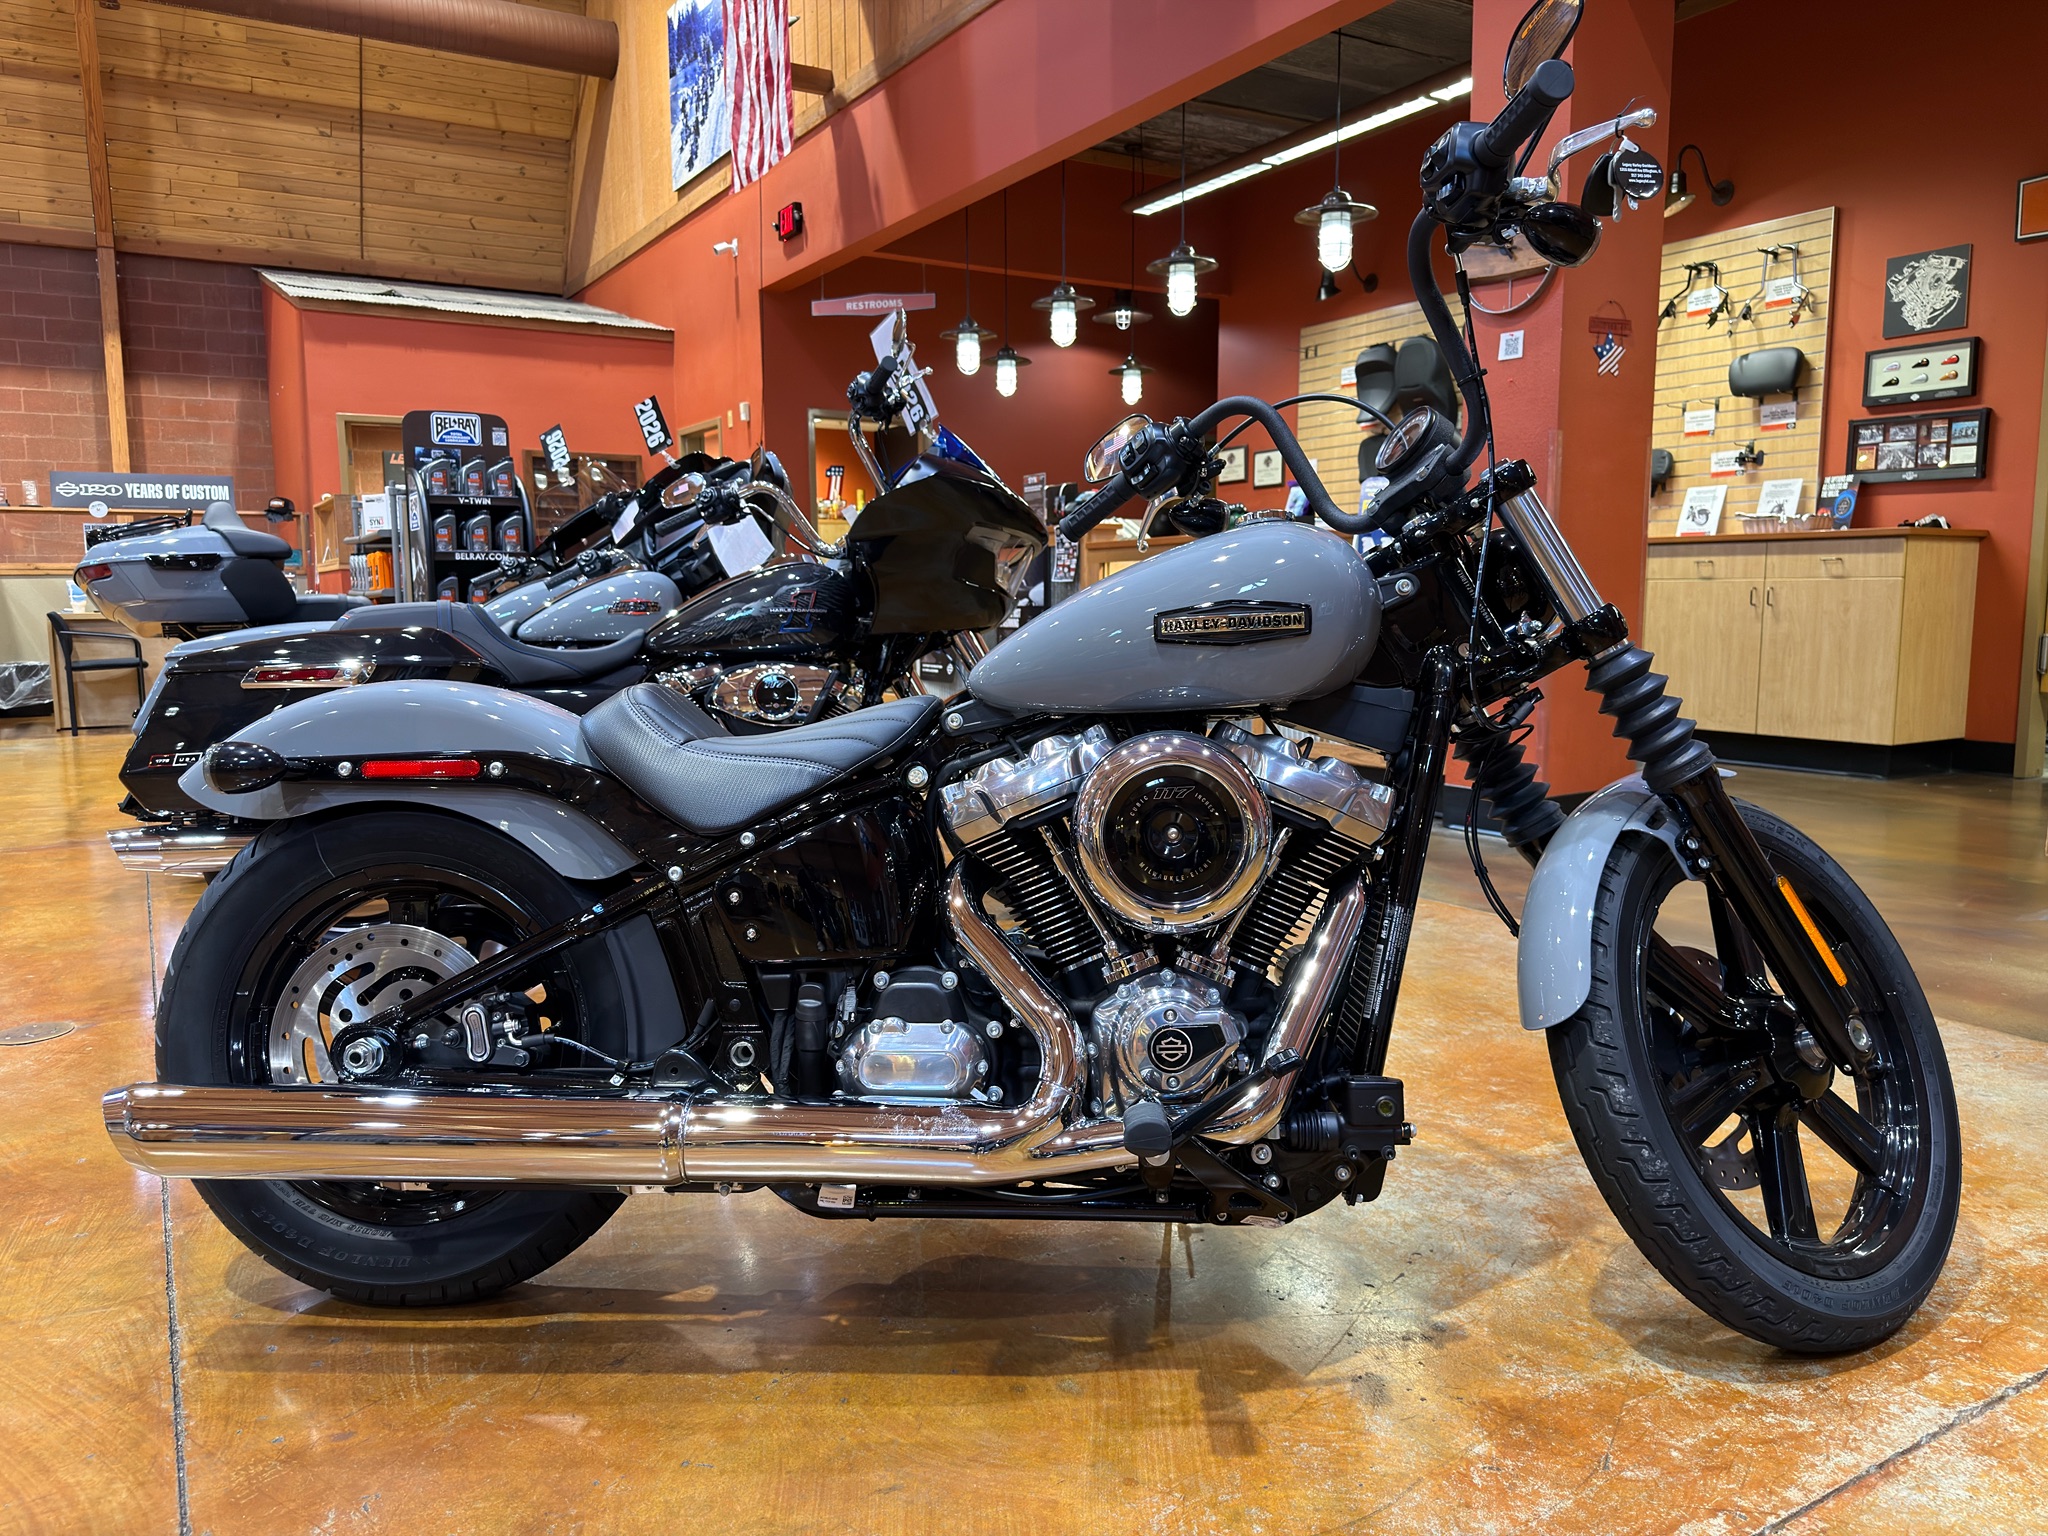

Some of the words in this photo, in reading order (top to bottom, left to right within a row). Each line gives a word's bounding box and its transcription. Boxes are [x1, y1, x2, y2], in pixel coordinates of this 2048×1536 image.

[846, 299, 903, 311] RESTROOMS
[634, 398, 666, 449] 2026
[79, 484, 122, 496] 120
[124, 482, 163, 500] YEARS
[164, 484, 180, 500] OF
[181, 485, 230, 501] CUSTOM
[458, 497, 491, 505] V-TWIN
[1163, 613, 1304, 633] HARLEY-DAVIDSON
[1153, 786, 1195, 800] 117
[1130, 795, 1149, 817] CUBIC
[1138, 859, 1212, 882] MILWAUKEE-EIGHT
